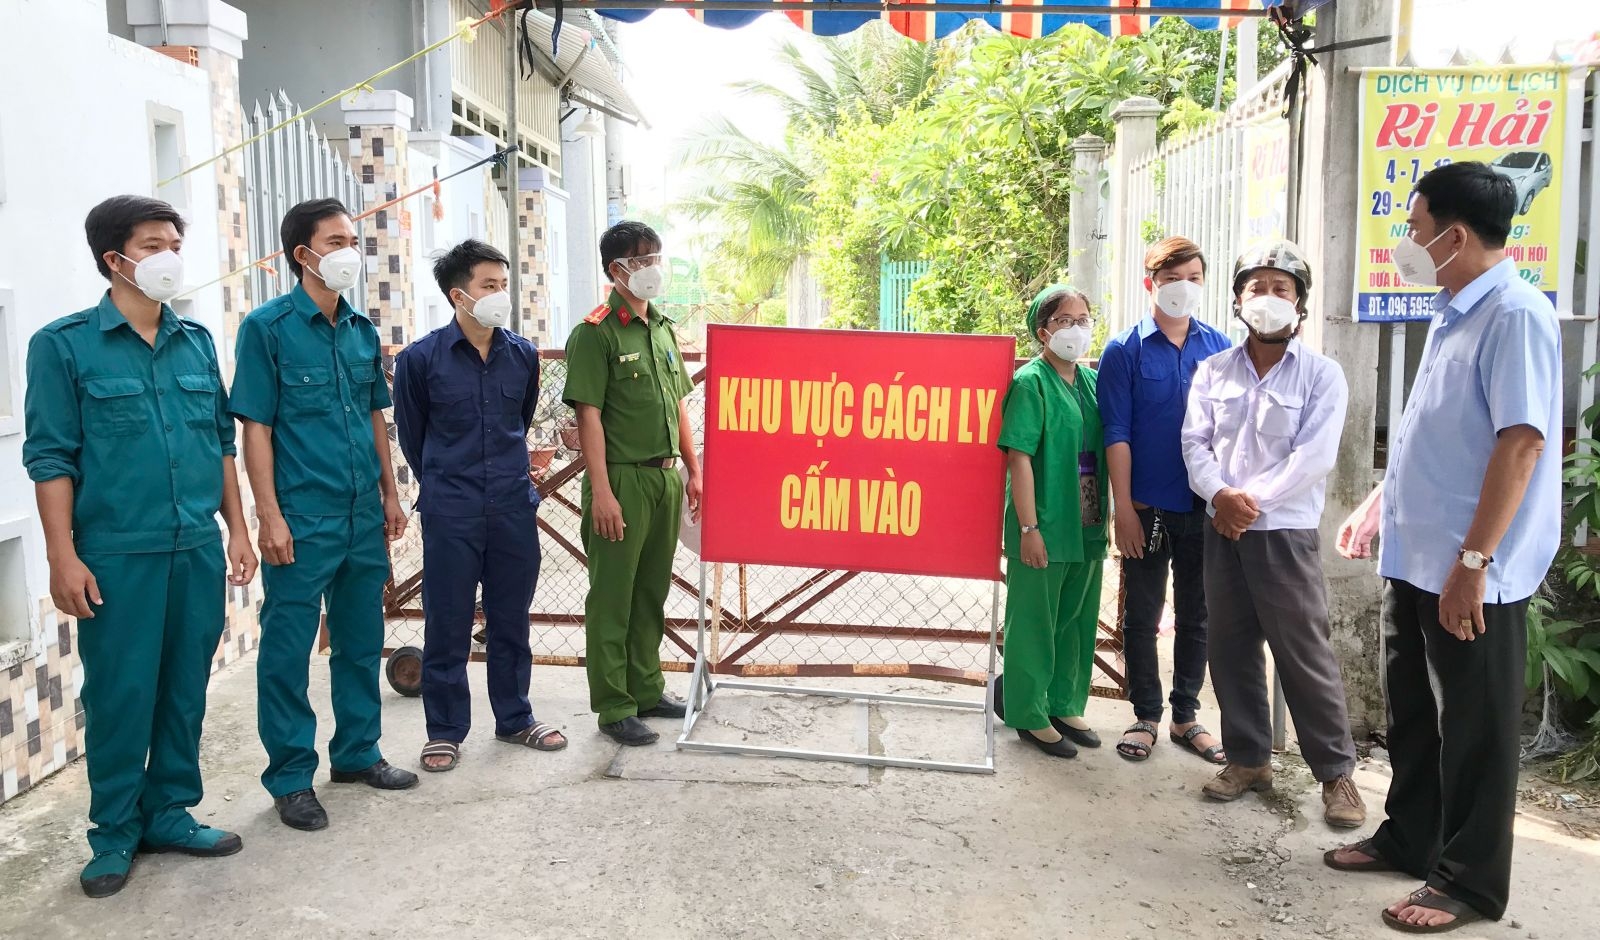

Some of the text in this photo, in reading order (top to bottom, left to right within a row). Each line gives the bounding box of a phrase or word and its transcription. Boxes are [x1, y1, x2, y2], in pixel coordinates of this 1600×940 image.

[1377, 75, 1428, 97] DỊCH
[1437, 75, 1464, 96] VỤ
[1508, 72, 1558, 95] LỊCH
[1376, 98, 1553, 148] Ri Hải
[1386, 159, 1396, 183] 4
[1411, 159, 1420, 183] 7
[1371, 191, 1392, 215] 29
[1369, 249, 1393, 263] THA
[1368, 296, 1385, 316] ĐT:
[1388, 296, 1408, 316] 096
[718, 372, 997, 447] KHU VỰC CÁCH LY
[780, 461, 922, 537] CẤM VÀO
